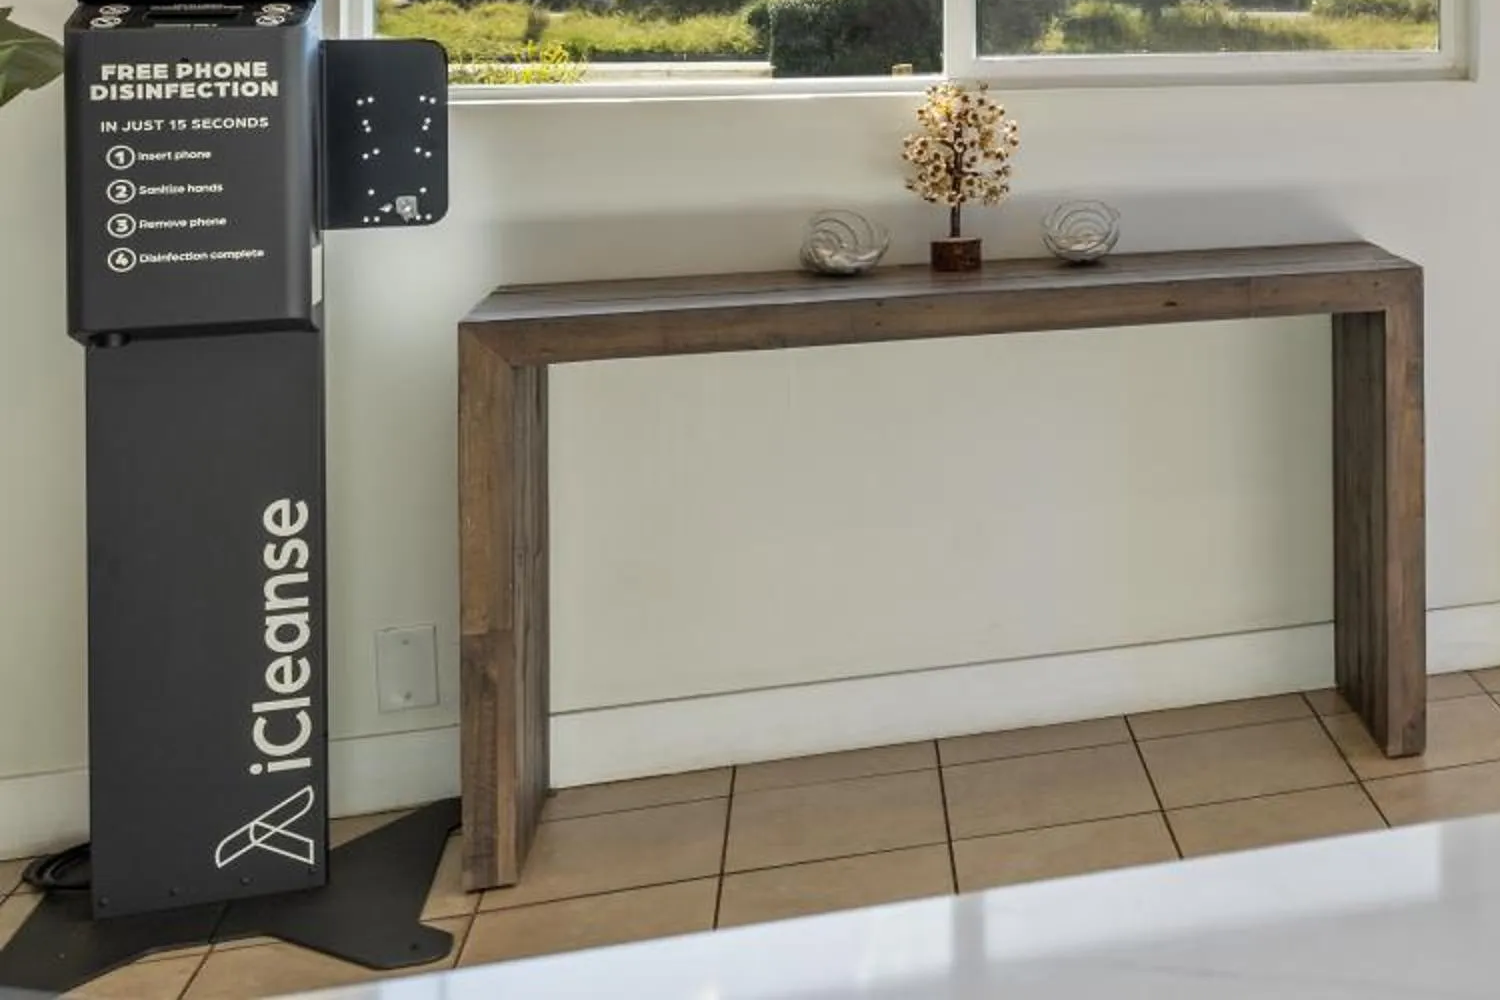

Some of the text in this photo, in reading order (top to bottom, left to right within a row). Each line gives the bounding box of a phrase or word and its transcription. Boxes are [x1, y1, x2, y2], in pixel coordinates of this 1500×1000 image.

[101, 62, 268, 82] FREE PHONE
[89, 80, 279, 101] DISINFECTION
[100, 117, 269, 133] IN JUST 15 SECONDS
[138, 151, 172, 161] Insert
[174, 149, 212, 162] phone
[138, 184, 185, 195] Sanitize
[187, 182, 223, 193] hands
[139, 218, 186, 229] Remove
[188, 216, 227, 229] phone
[140, 251, 208, 264] Disinfection
[210, 249, 265, 262] complete
[249, 498, 313, 776] iCleanse
